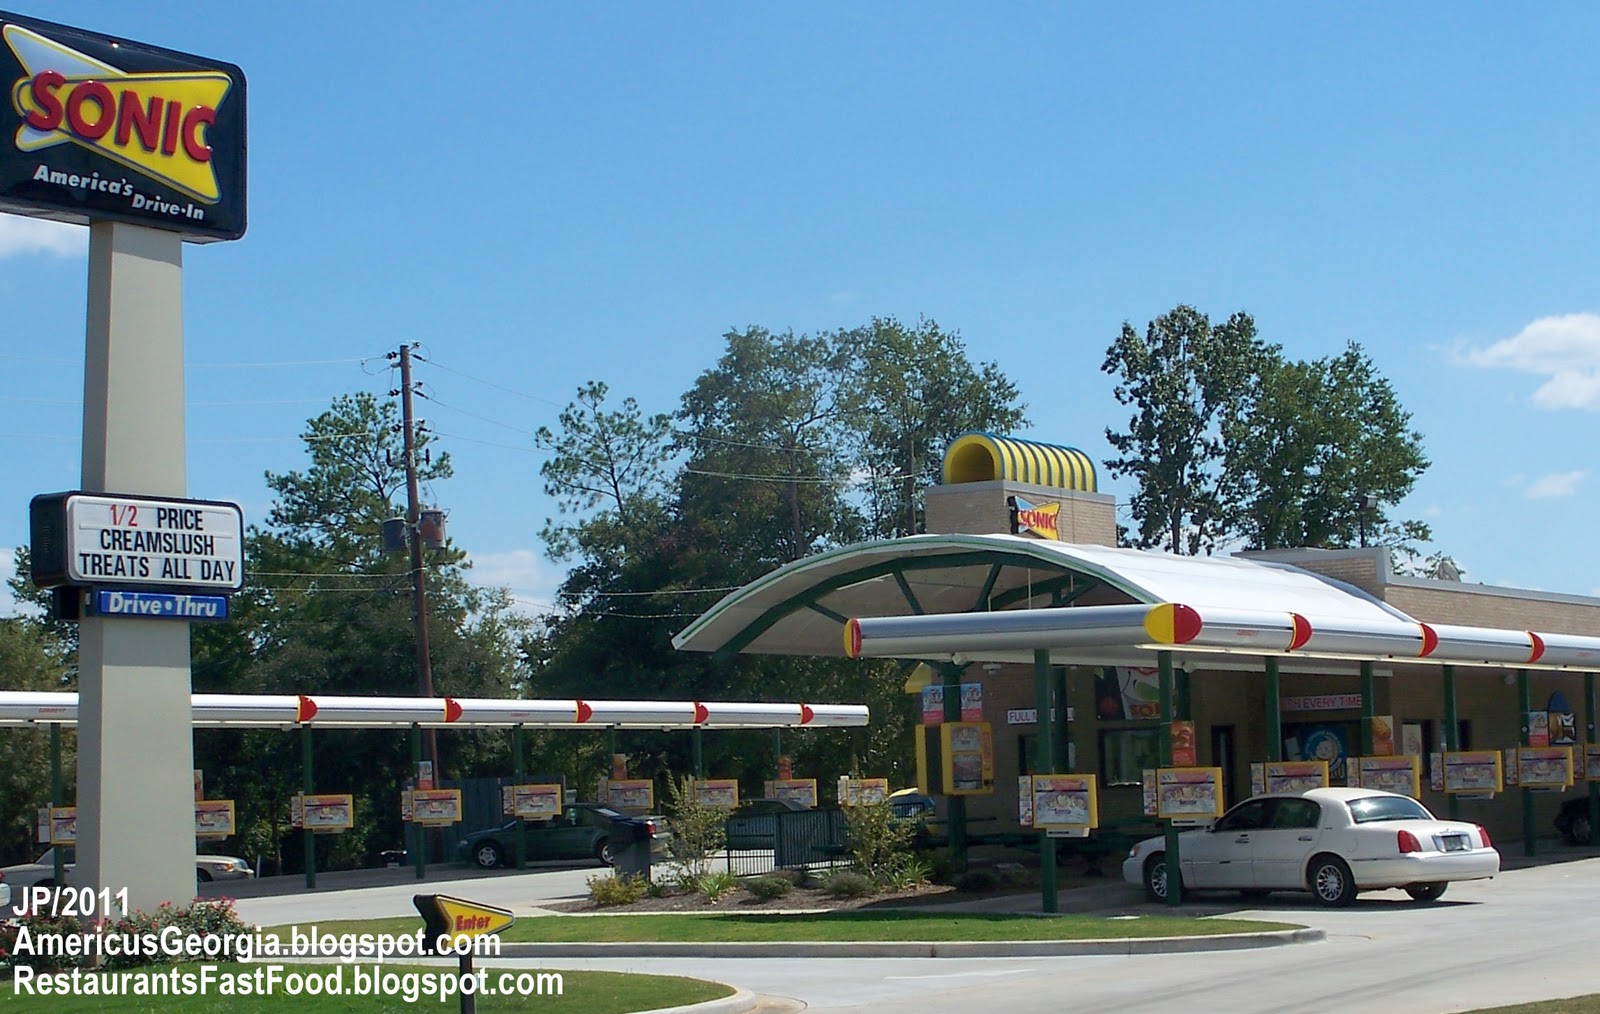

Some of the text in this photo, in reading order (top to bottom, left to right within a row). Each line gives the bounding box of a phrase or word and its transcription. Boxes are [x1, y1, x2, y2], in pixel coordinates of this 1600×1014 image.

[25, 69, 216, 163] SONIC
[33, 165, 133, 197] America's
[110, 504, 203, 531] 1/2 PRICE
[1020, 509, 1057, 530] SONIC
[100, 529, 214, 556] CREAMSLUSH
[79, 553, 235, 582] TREATS ALL DAY
[1303, 697, 1337, 709] EVERY
[456, 914, 492, 931] Enter
